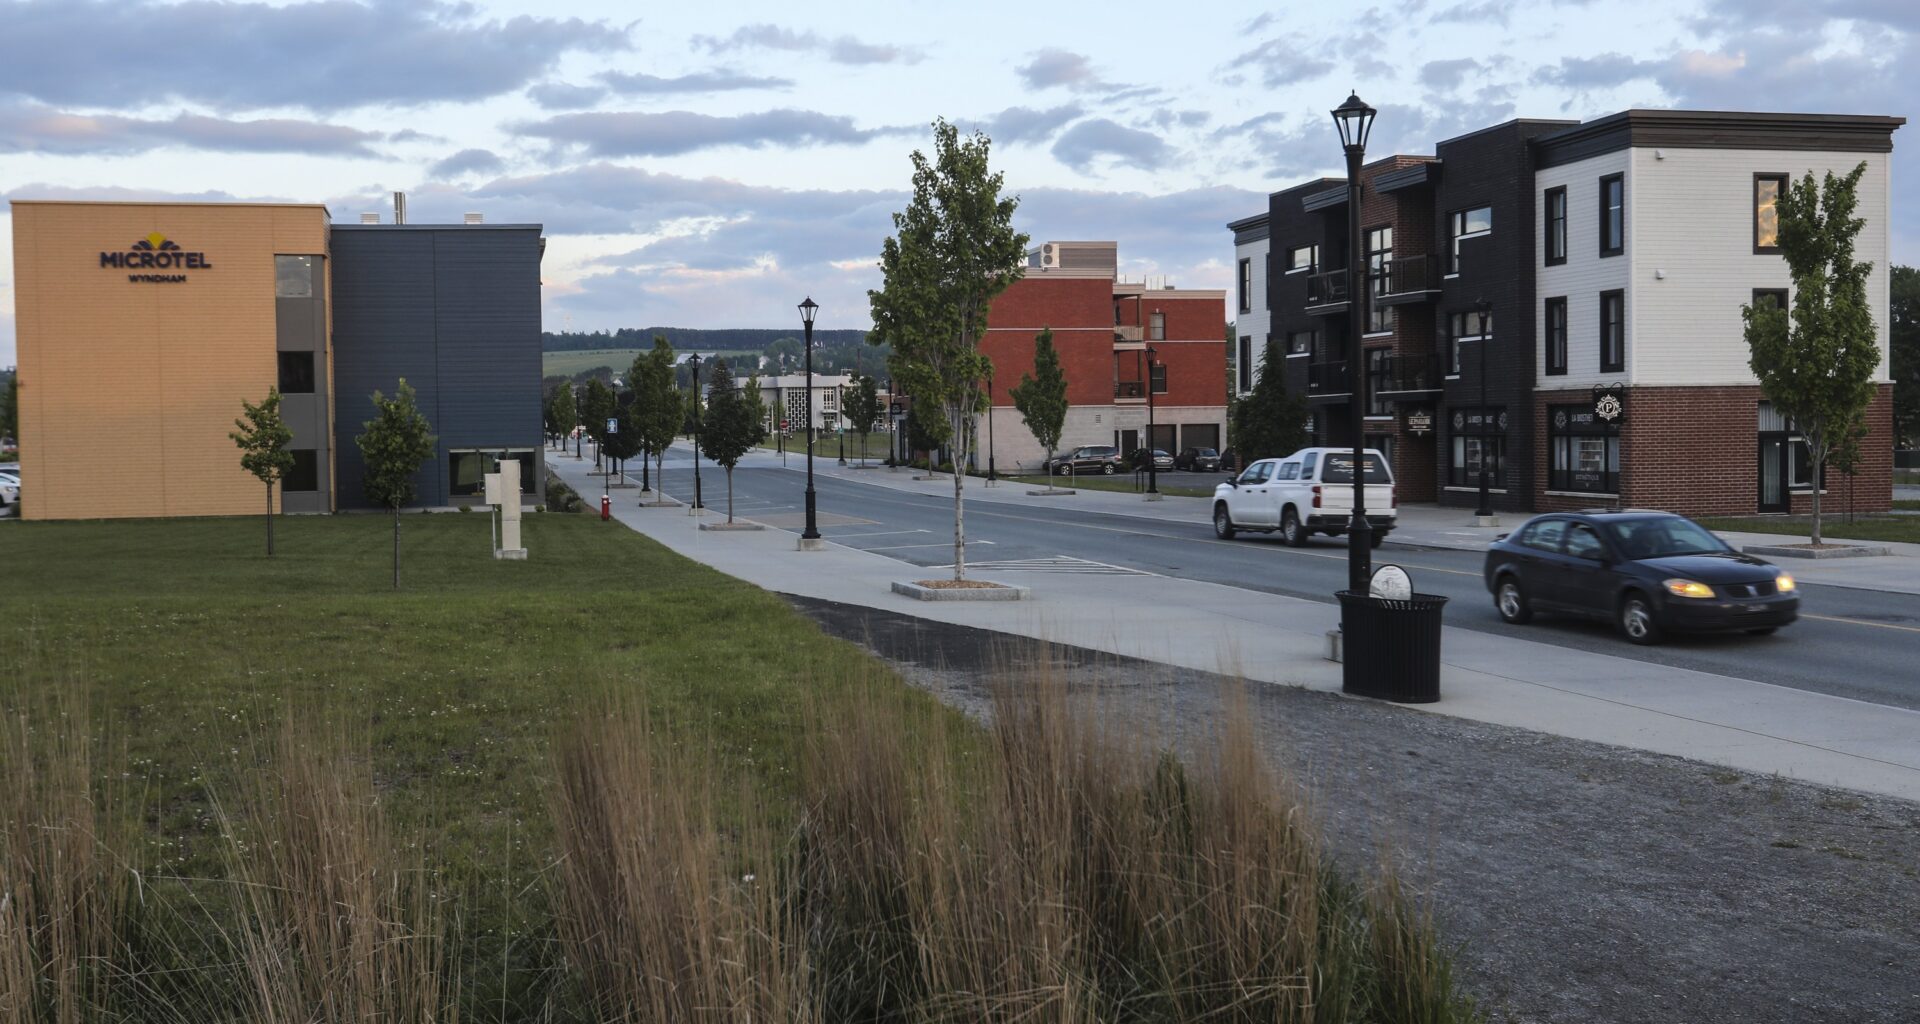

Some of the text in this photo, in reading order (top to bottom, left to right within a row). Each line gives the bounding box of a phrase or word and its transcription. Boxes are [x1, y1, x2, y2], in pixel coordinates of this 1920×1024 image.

[100, 251, 212, 268] MICROTEL
[128, 274, 187, 282] WYNDHAM
[1605, 403, 1613, 413] P
